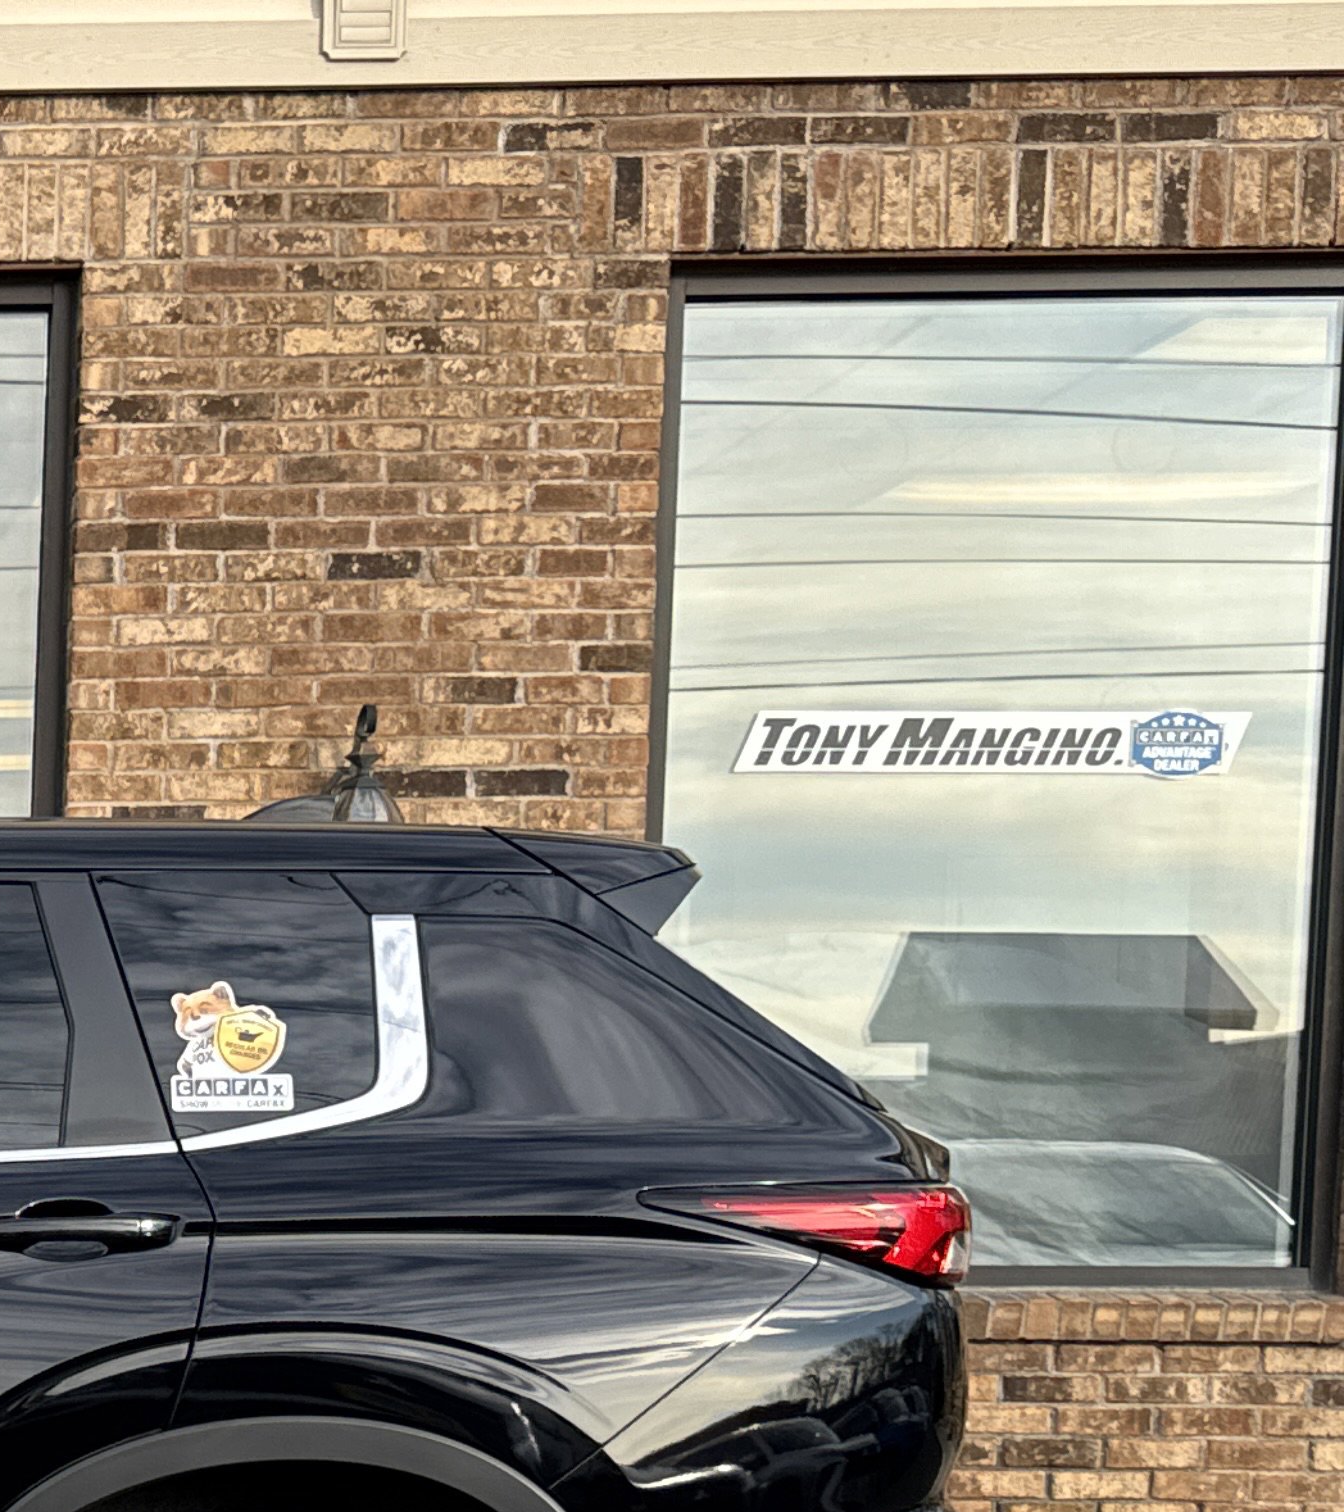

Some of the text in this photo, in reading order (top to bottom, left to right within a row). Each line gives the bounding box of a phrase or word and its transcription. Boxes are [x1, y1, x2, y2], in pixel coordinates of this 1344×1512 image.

[753, 717, 890, 767] TONY
[1141, 746, 1212, 759] ADVANTAGE
[1153, 758, 1200, 772] DEALER
[176, 1078, 288, 1097] CARFAX
